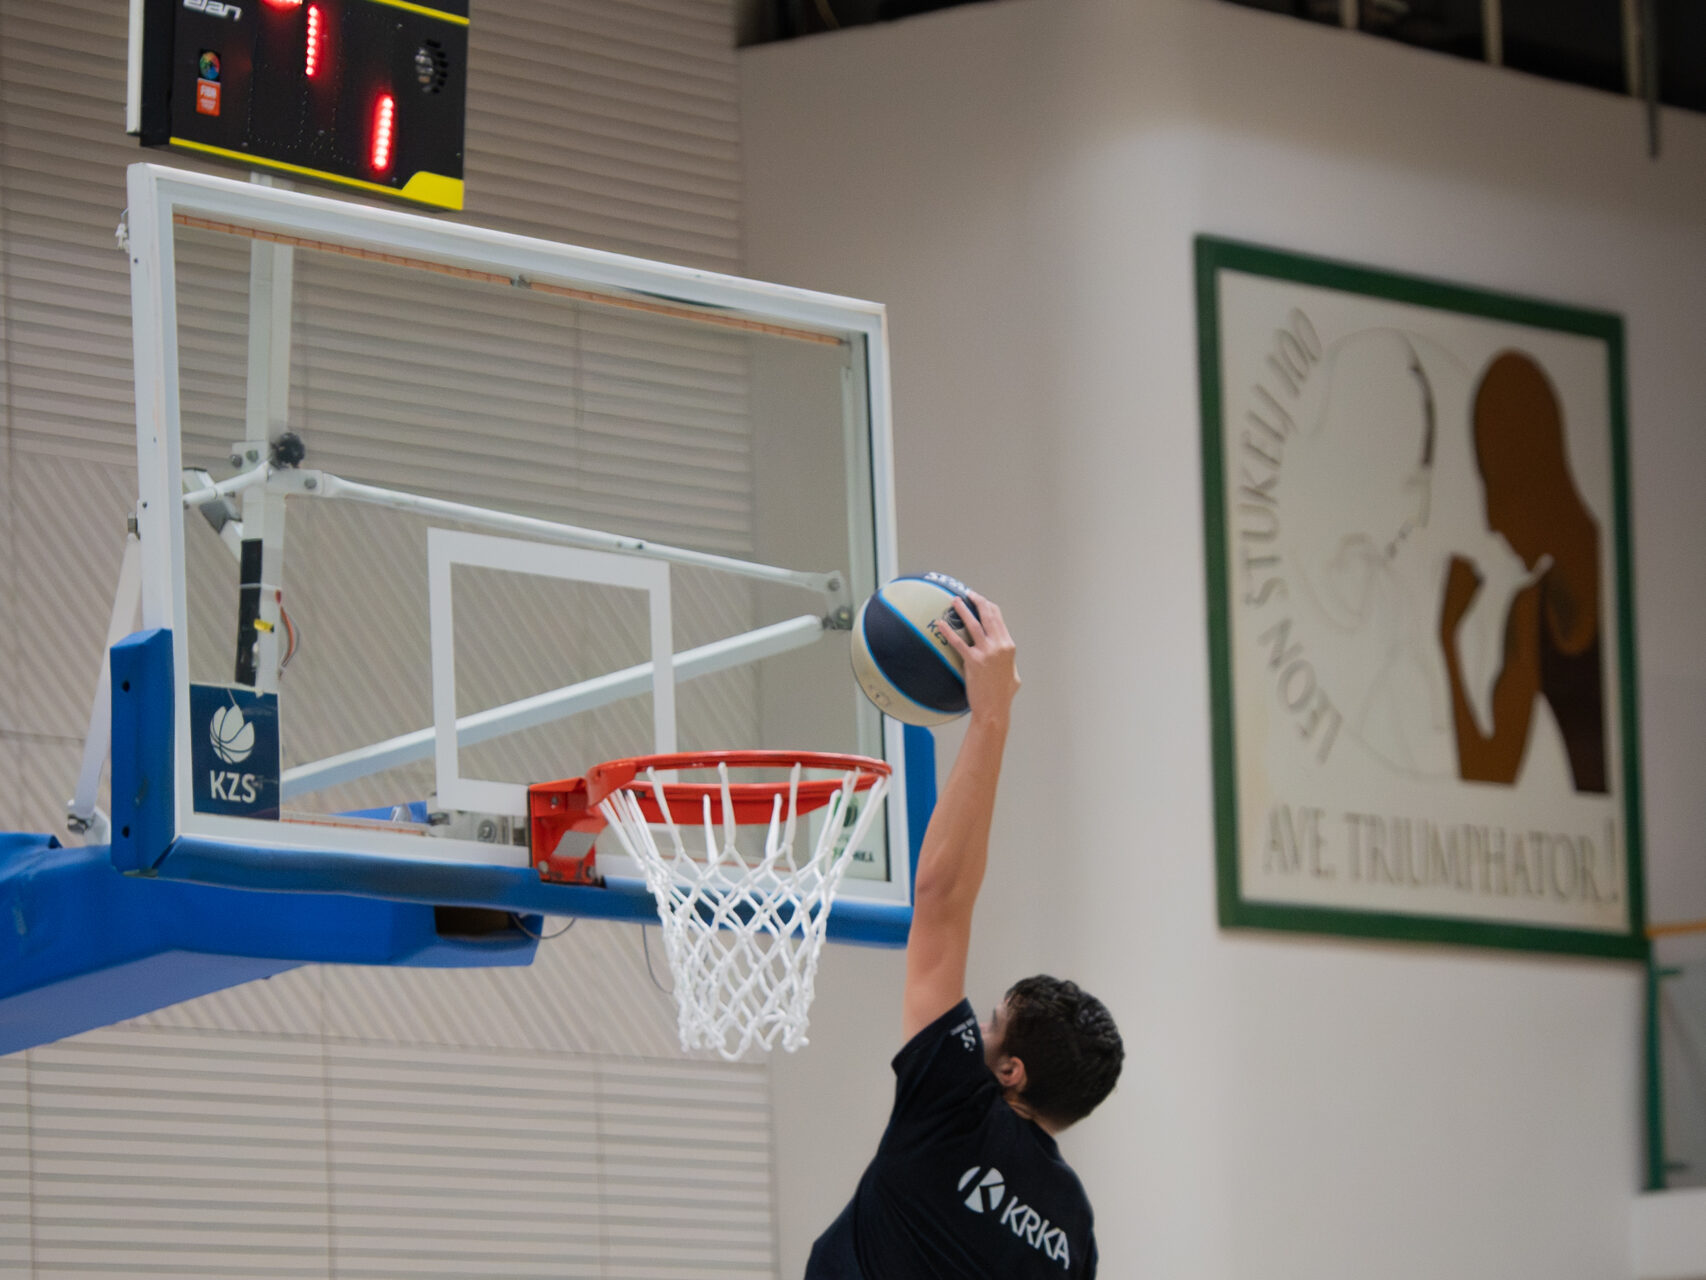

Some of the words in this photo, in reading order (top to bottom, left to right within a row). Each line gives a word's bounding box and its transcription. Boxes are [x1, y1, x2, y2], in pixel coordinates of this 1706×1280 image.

[1265, 306, 1321, 398] 100
[1257, 615, 1344, 767] LEON
[210, 769, 256, 804] KZS
[1000, 1196, 1070, 1270] KRKA
